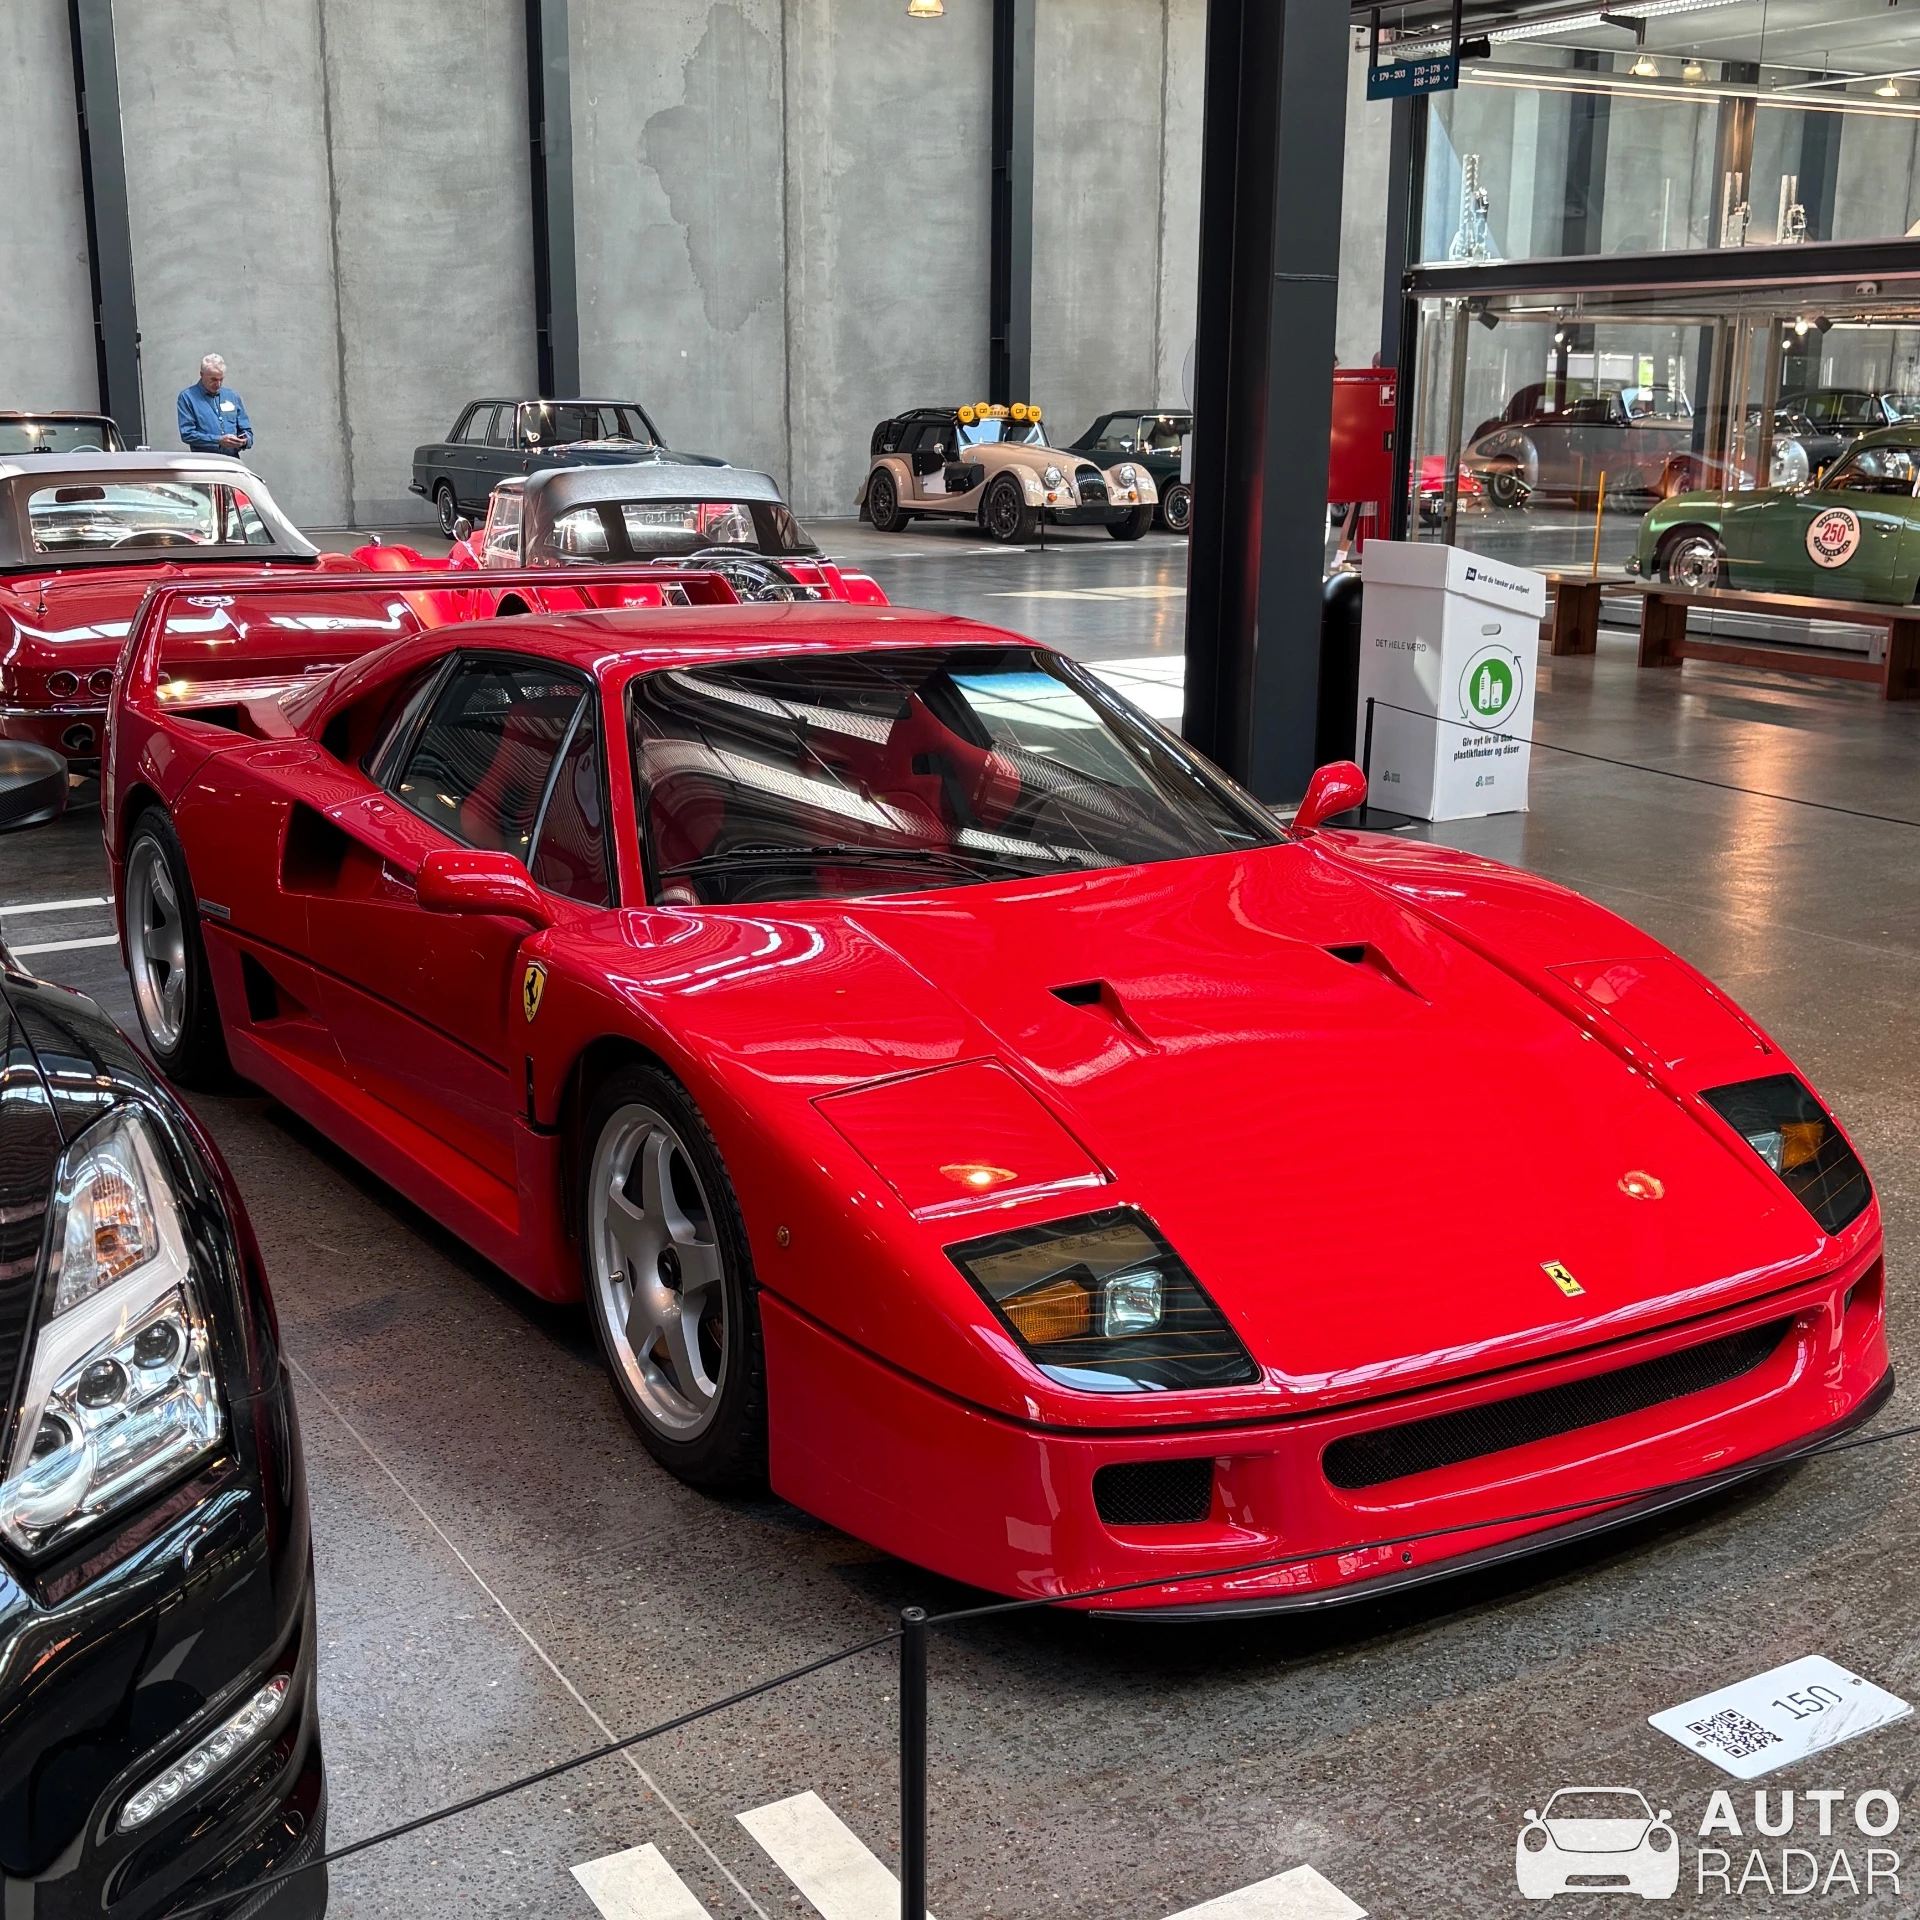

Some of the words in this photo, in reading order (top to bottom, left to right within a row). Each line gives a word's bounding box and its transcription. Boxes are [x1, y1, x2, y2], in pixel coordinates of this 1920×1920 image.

[1821, 522, 1846, 543] 250
[1375, 638, 1388, 648] DET
[1388, 641, 1406, 650] HELE
[1407, 642, 1427, 652] VÆRD
[1462, 737, 1473, 747] Giv
[1473, 736, 1483, 747] nyt
[1484, 735, 1492, 744] liv
[1453, 748, 1493, 762] plastikflasker
[1494, 747, 1502, 757] og
[1503, 745, 1520, 754] dåser
[1771, 1684, 1843, 1720] 150
